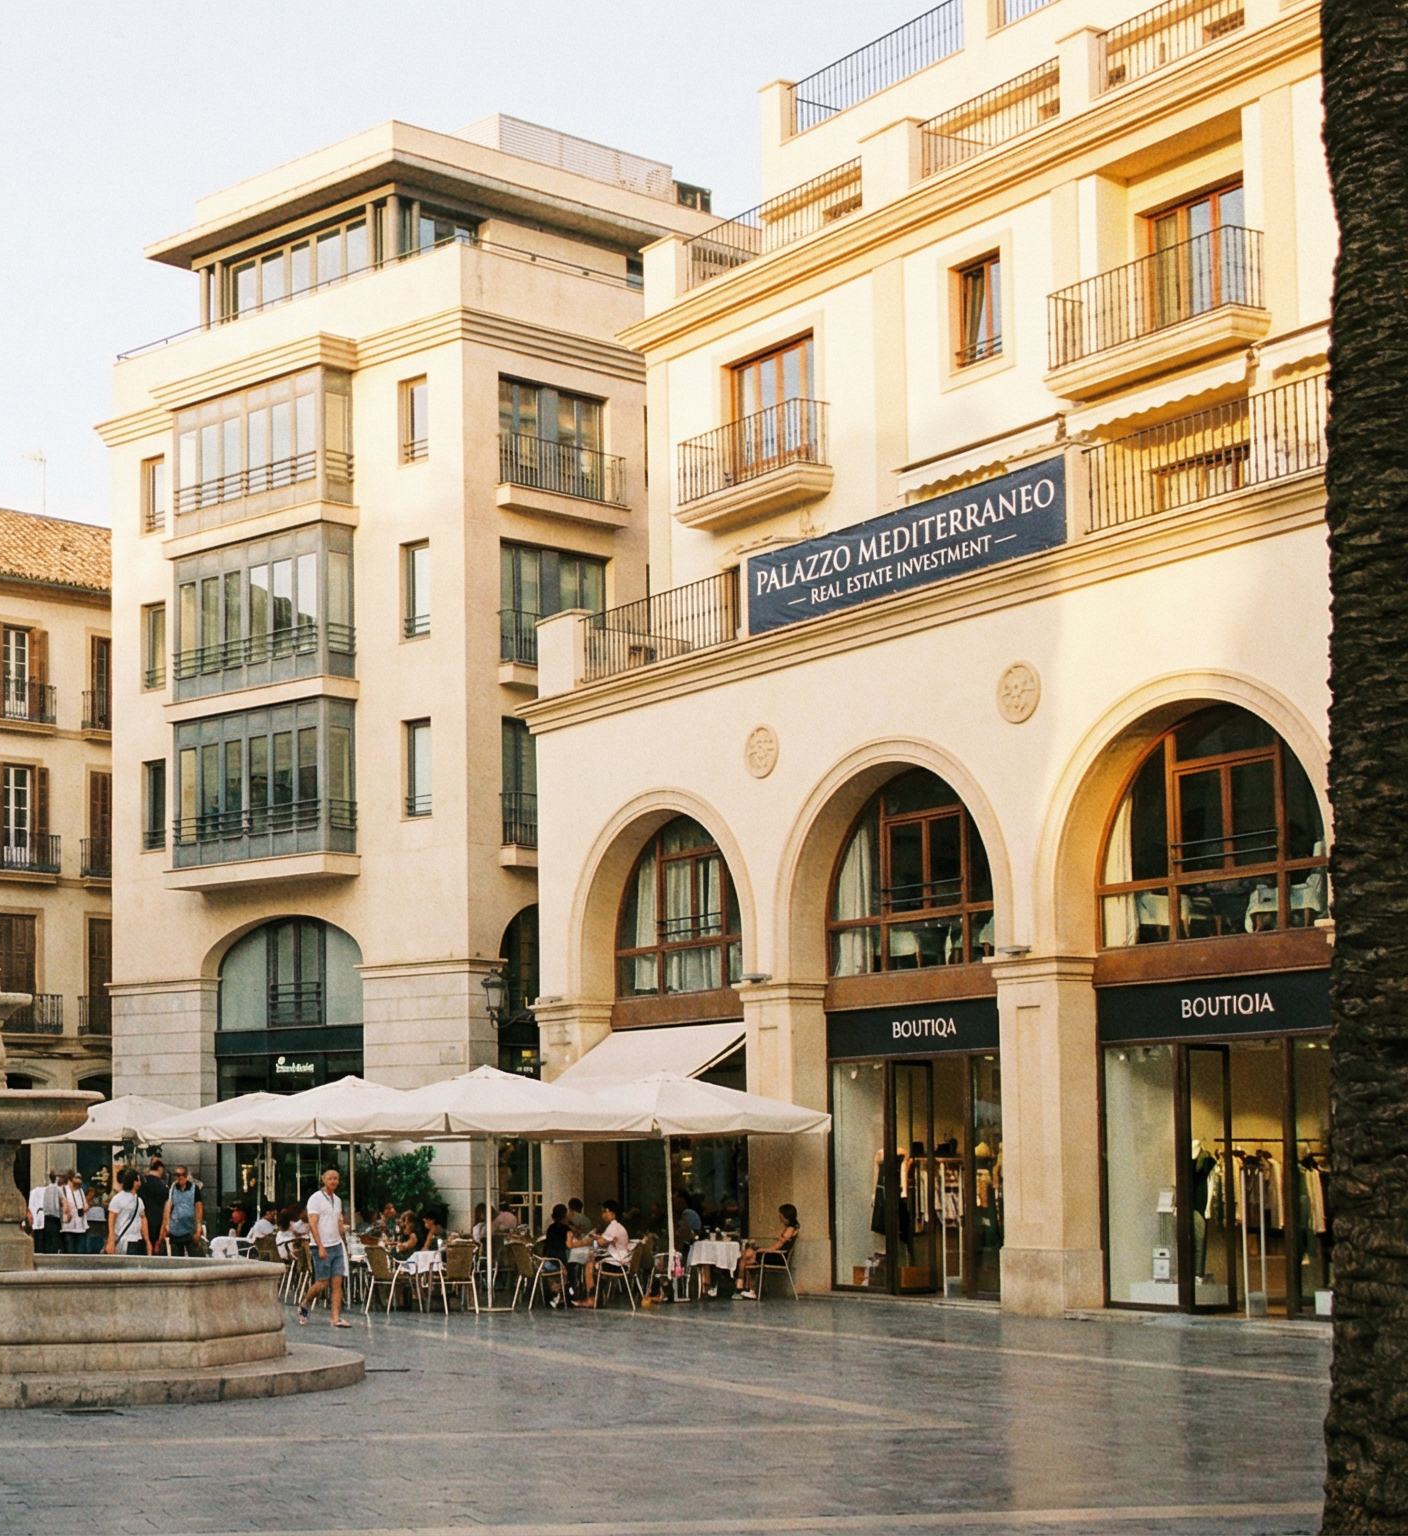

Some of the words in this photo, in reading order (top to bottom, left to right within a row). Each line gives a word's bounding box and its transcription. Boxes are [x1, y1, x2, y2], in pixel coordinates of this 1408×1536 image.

[756, 546, 851, 596] PALAZZO
[858, 479, 1055, 566] MEDITERRANEO
[811, 583, 844, 605] REAL
[847, 565, 893, 594] ESTATE
[896, 535, 992, 578] INVESTMENT
[892, 1017, 957, 1039] BOUTIQA
[1181, 993, 1275, 1019] BOUTIQIA
